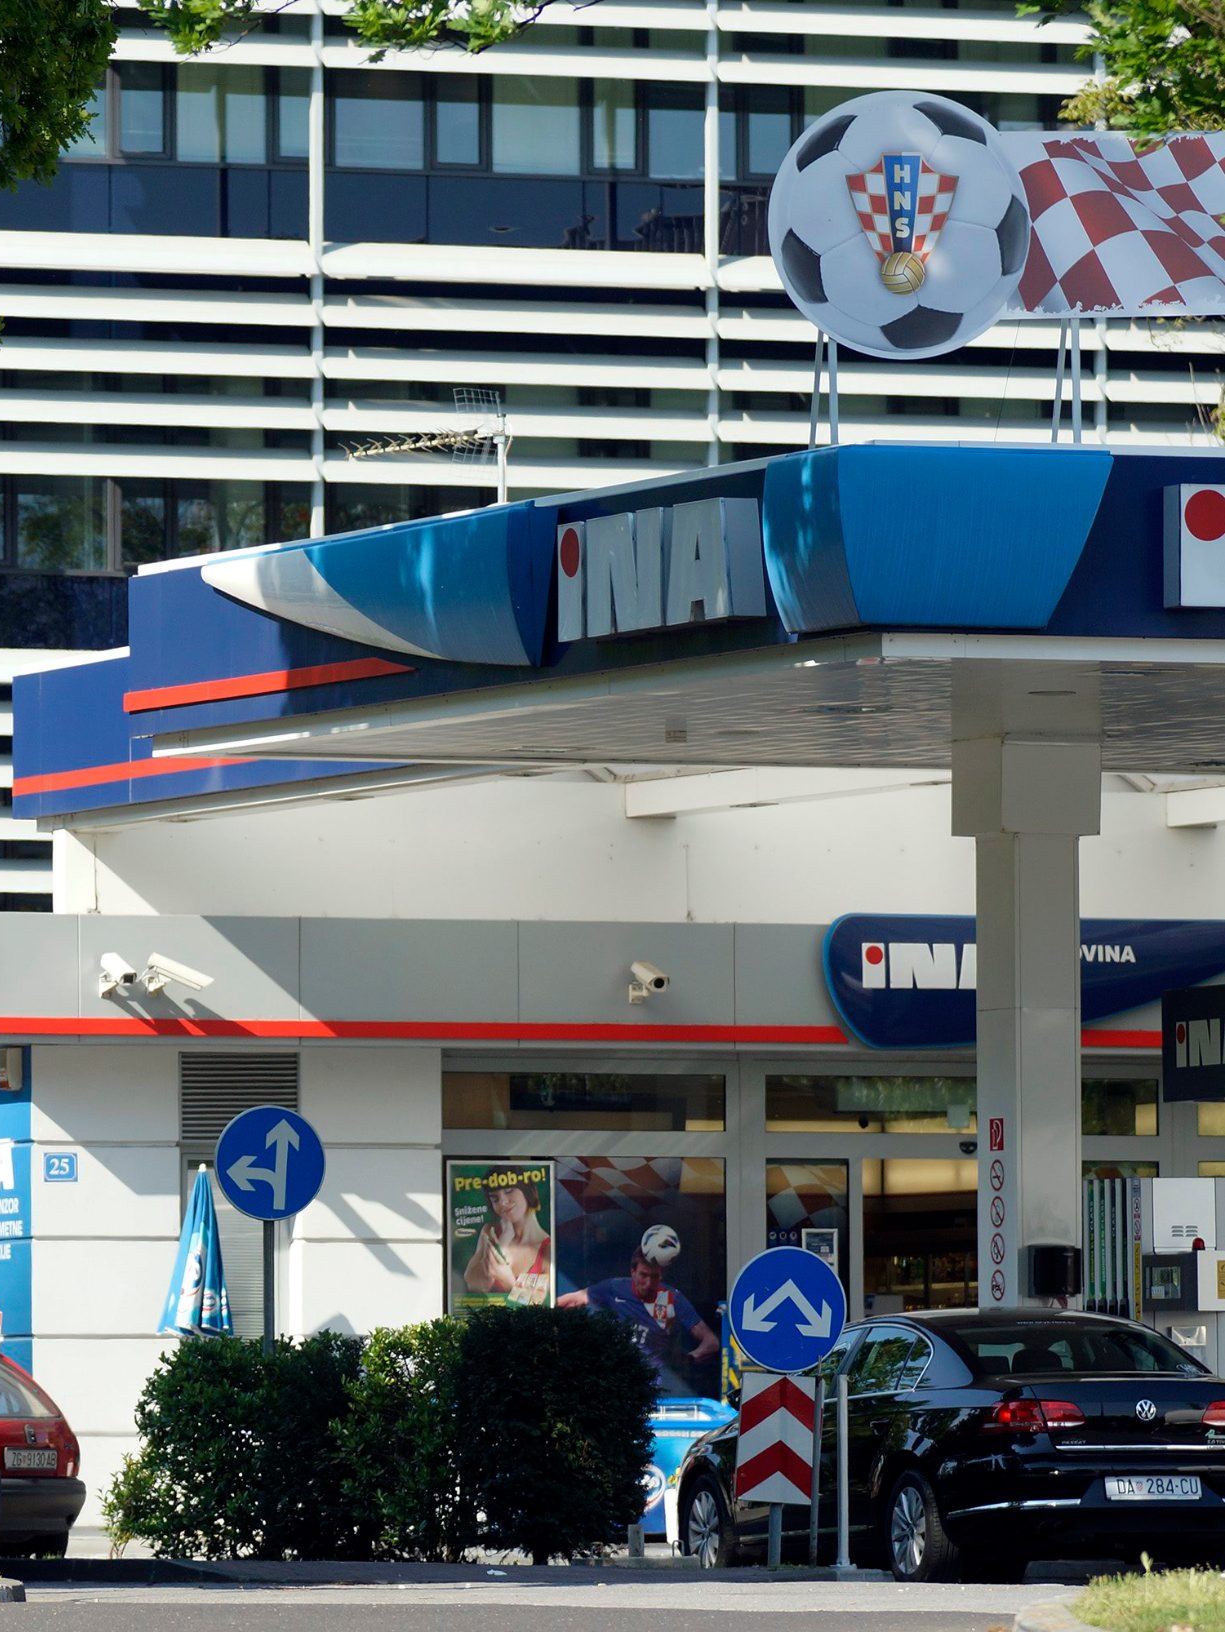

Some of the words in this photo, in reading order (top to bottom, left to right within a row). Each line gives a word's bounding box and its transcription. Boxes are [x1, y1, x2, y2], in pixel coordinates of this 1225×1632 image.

[893, 163, 911, 239] HNS
[1079, 944, 1136, 963] VINA
[1176, 1018, 1225, 1068] IN
[48, 1158, 70, 1175] 25
[454, 1168, 546, 1192] Pre-dob-ro!
[1117, 1478, 1135, 1495] DA
